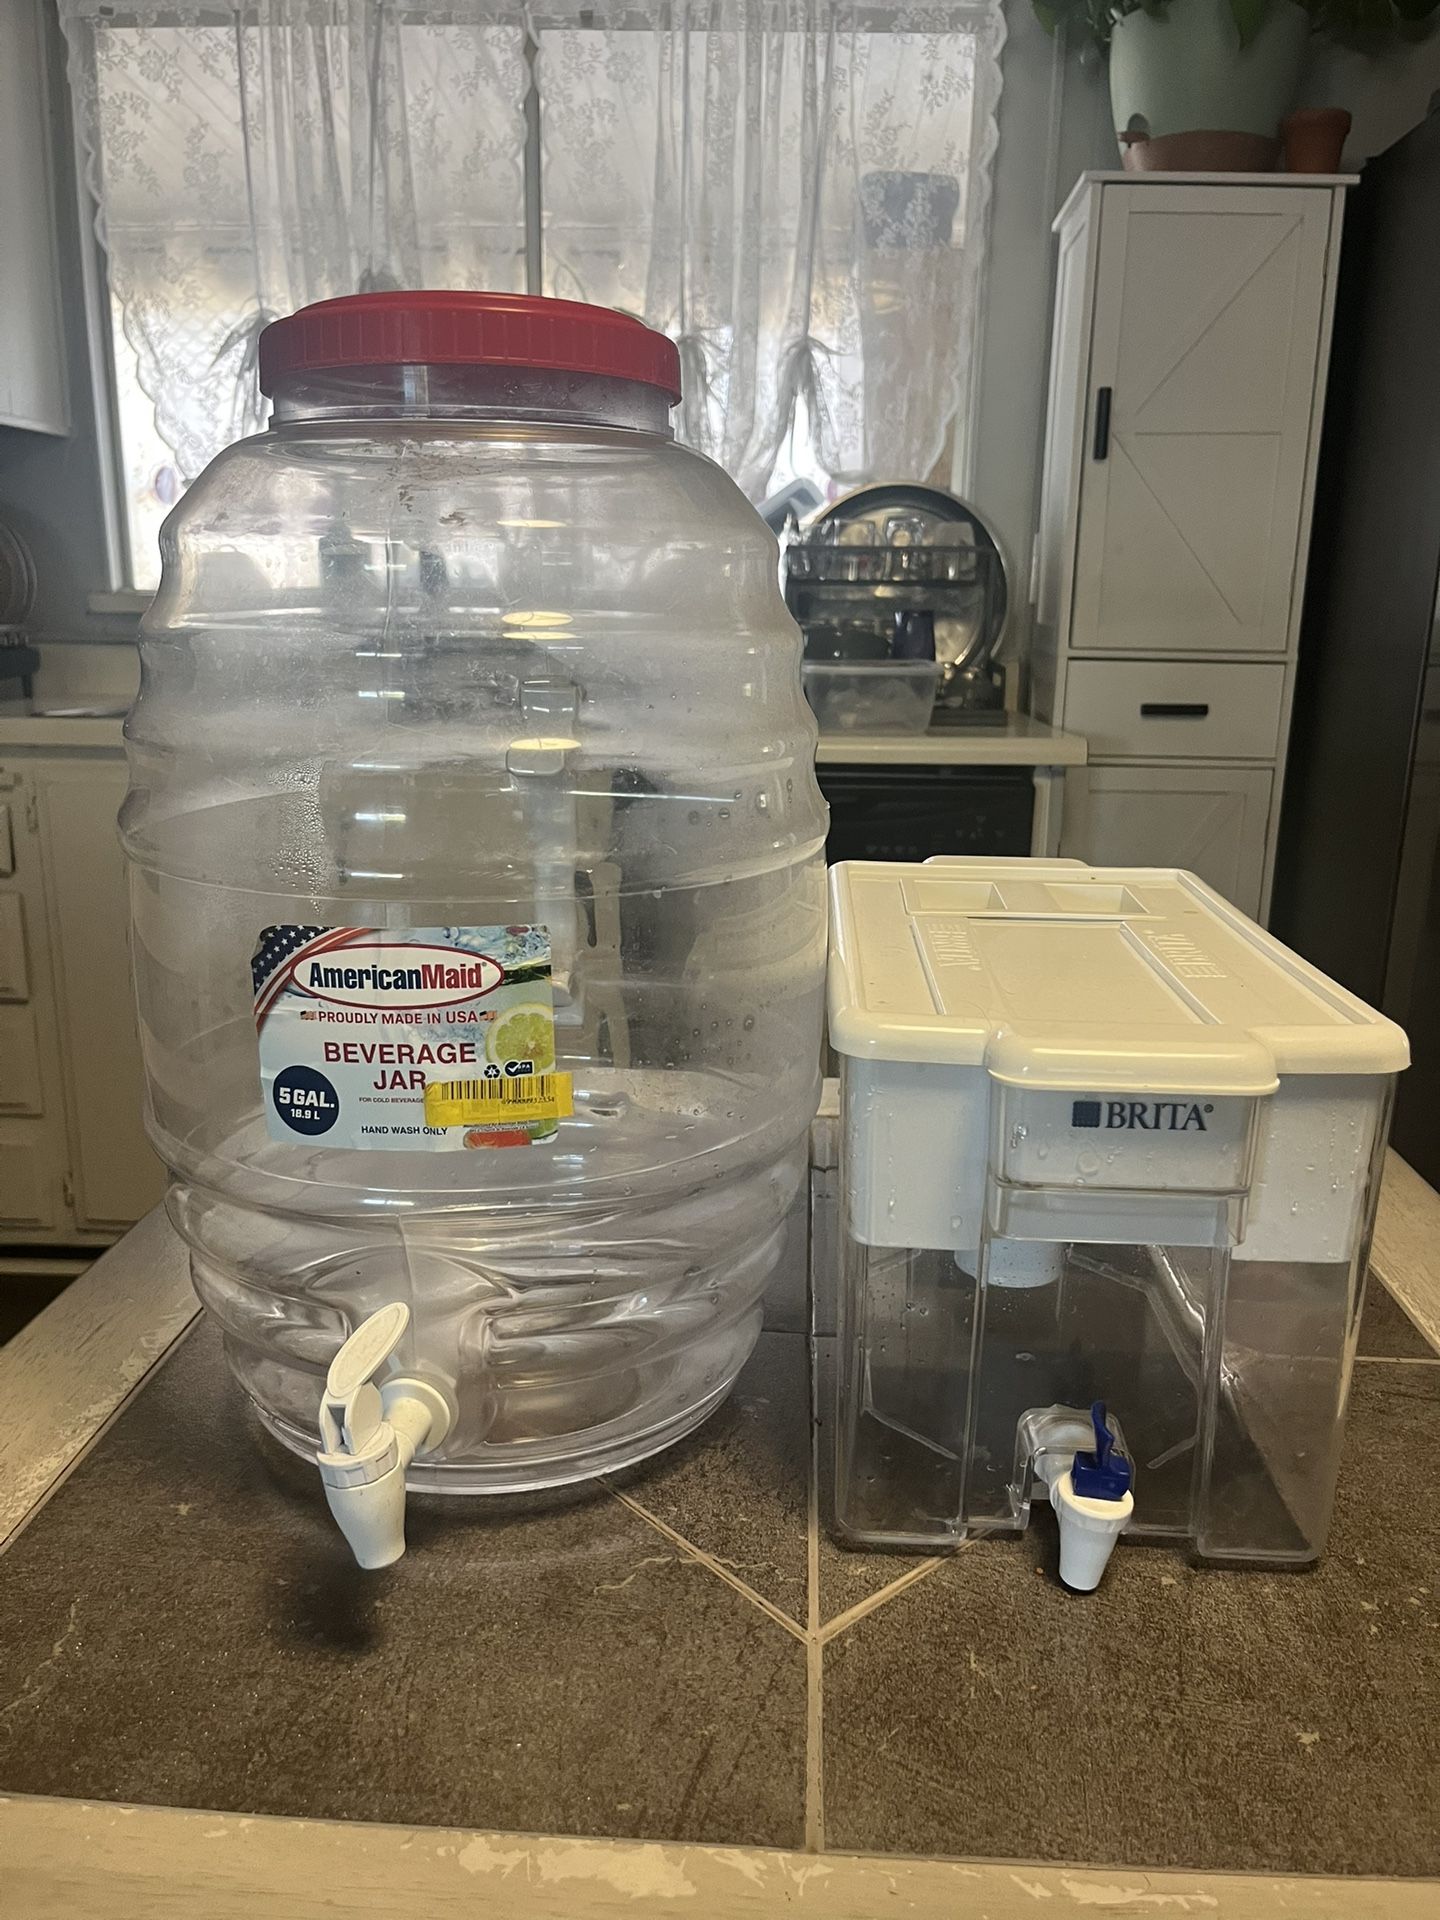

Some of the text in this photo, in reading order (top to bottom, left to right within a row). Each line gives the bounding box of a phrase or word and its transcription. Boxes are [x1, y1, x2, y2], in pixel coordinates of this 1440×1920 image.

[318, 1010, 479, 1025] PROUDLY MADE IN USA
[323, 1041, 477, 1065] BEVERAGE
[373, 1069, 427, 1090] JAR
[279, 1086, 335, 1108] 5 GAL.
[290, 1108, 321, 1120] 18.9 L
[361, 1125, 448, 1136] HAND WASH ONLY
